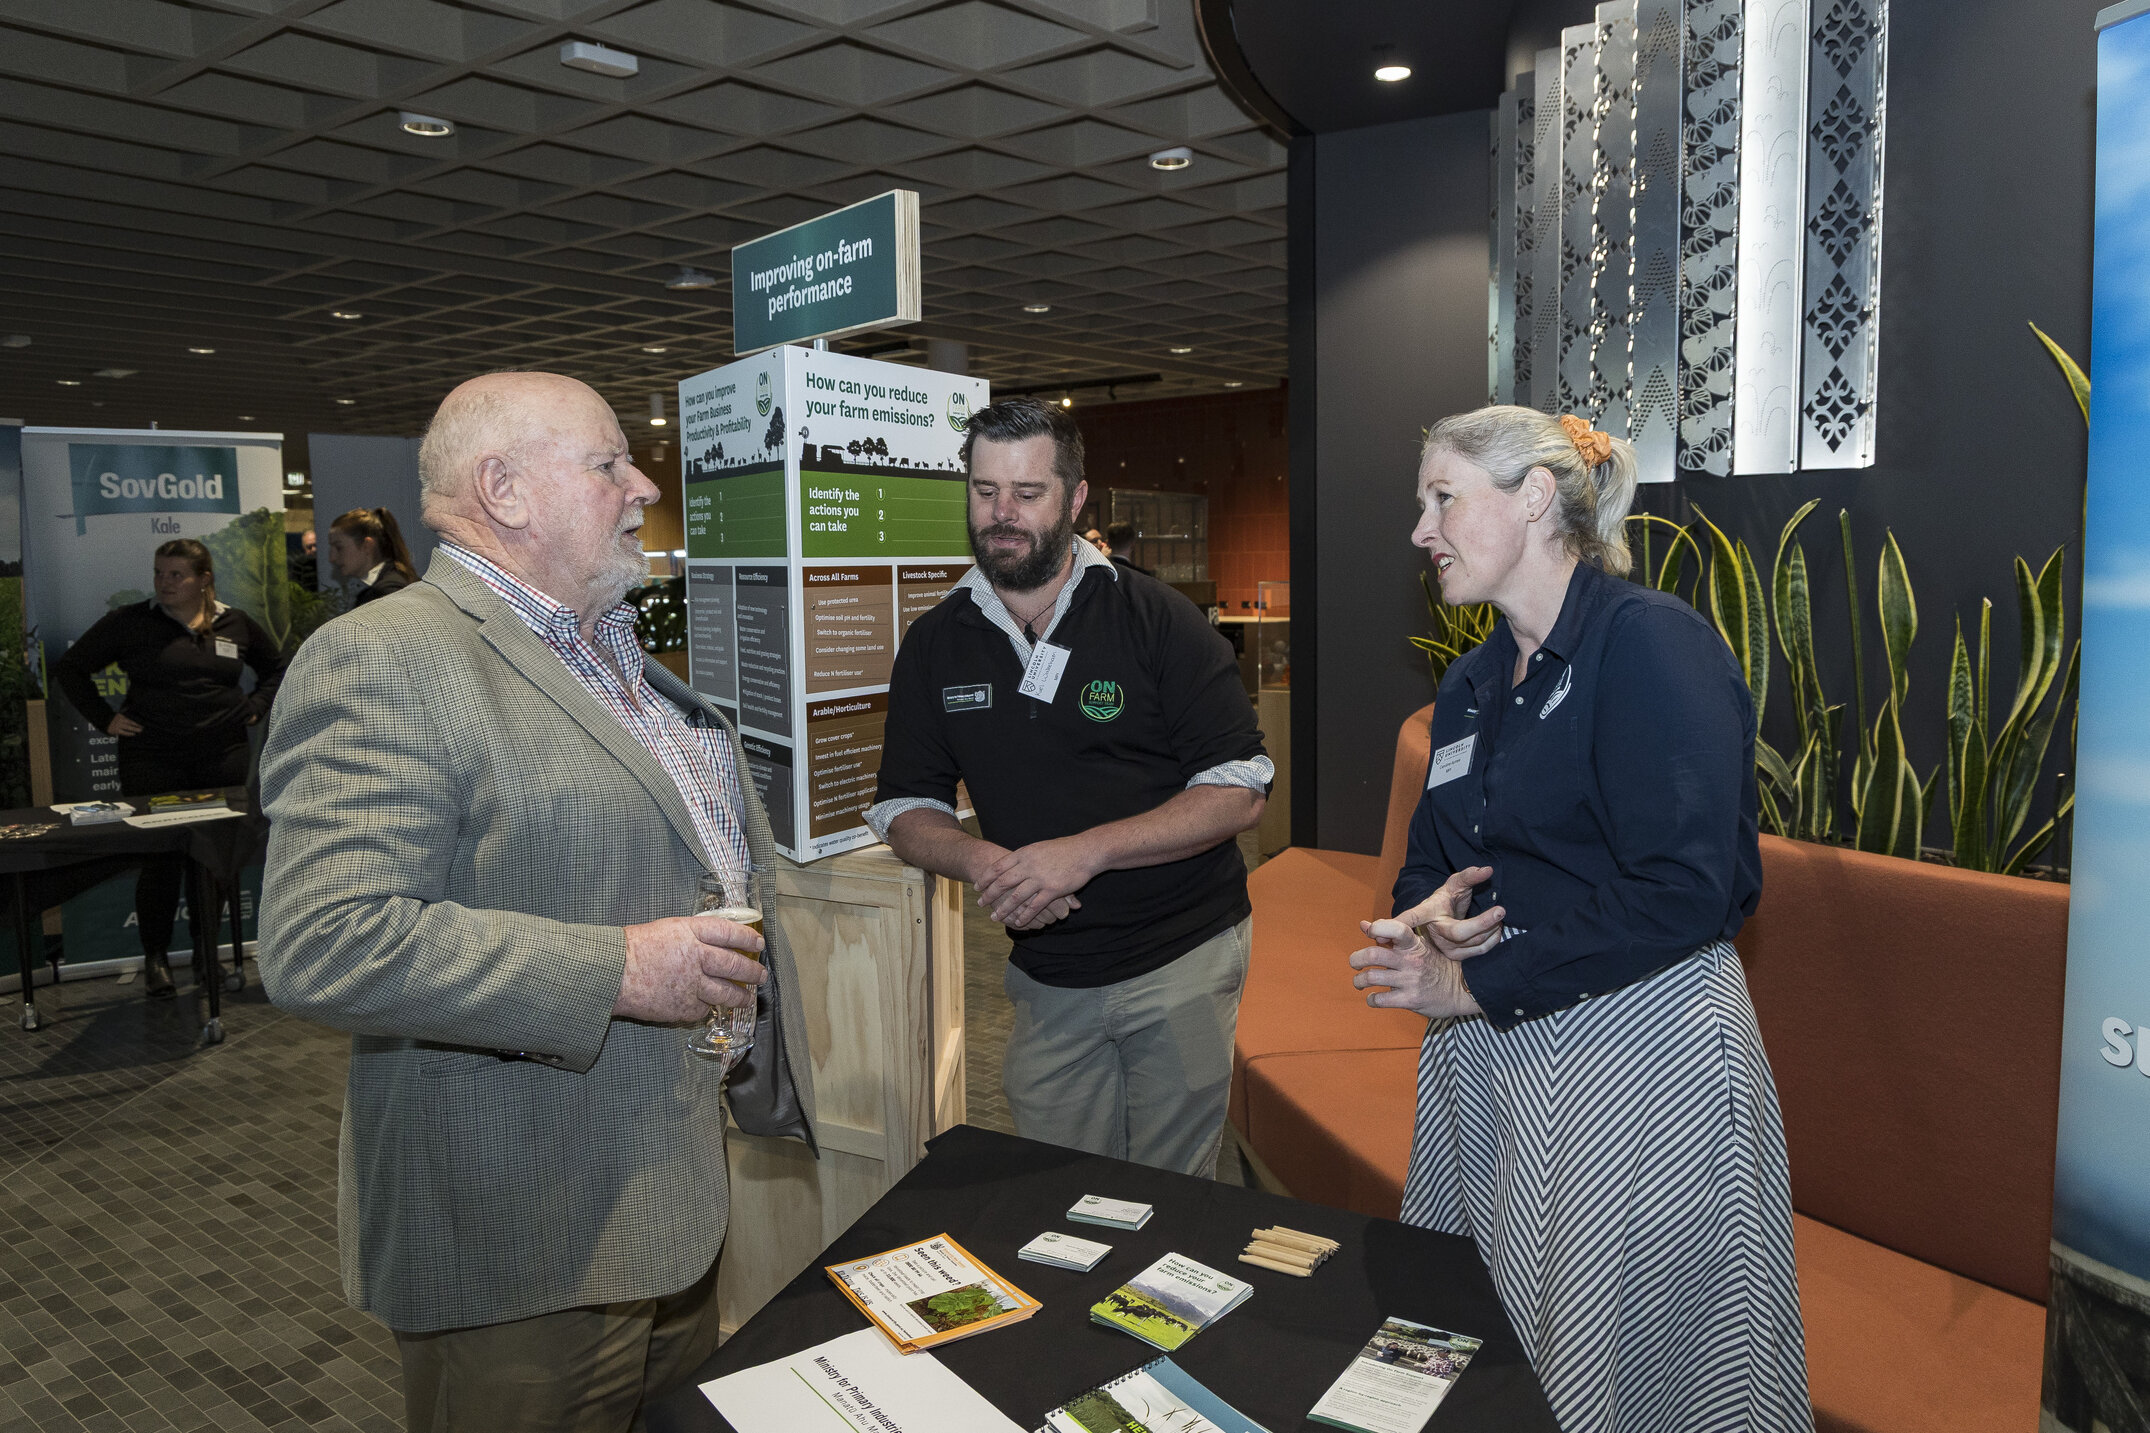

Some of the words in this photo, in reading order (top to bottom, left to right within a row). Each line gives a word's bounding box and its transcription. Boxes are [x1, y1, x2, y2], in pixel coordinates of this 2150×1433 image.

[751, 255, 814, 293] Improving
[816, 237, 872, 272] on-farm
[768, 275, 852, 320] performance
[759, 371, 768, 386] ON
[685, 394, 696, 407] How
[696, 393, 705, 403] can
[705, 390, 714, 405] you
[714, 383, 736, 400] improve
[806, 372, 835, 391] How
[839, 379, 861, 394] can
[864, 384, 886, 400] you
[888, 386, 928, 404] reduce
[952, 392, 964, 406] ON
[686, 413, 696, 428] your
[697, 410, 709, 422] Farm
[710, 404, 732, 418] Business
[806, 400, 836, 418] your
[840, 400, 869, 420] farm
[872, 406, 935, 428] emissions?
[686, 425, 715, 442] Productivity
[715, 424, 719, 436] &
[720, 416, 751, 436] Profitability
[100, 472, 223, 499] SovGold
[878, 488, 883, 498] 1
[689, 496, 704, 508] Identify
[809, 487, 844, 503] Identify
[845, 489, 860, 501] the
[690, 511, 703, 521] actions
[809, 504, 842, 516] actions
[843, 506, 860, 520] you
[151, 516, 180, 534] Kale
[698, 525, 706, 535] take
[810, 522, 826, 532] can
[827, 520, 847, 532] take
[903, 571, 927, 579] Livestock
[928, 570, 947, 580] Specific
[827, 597, 848, 606] protected
[860, 614, 875, 622] fertility
[1028, 655, 1039, 678] LINCOLN
[1032, 646, 1046, 680] UNIVERSITY
[1090, 680, 1115, 693] ON
[1089, 692, 1115, 702] FARM
[813, 702, 871, 717] Arable/Horticulture
[844, 747, 860, 755] efficient
[861, 744, 882, 752] machinery
[90, 754, 117, 764] Late
[814, 768, 834, 777] Optimise
[834, 764, 852, 772] fertiliser
[840, 777, 855, 785] electric
[856, 772, 877, 781] machinery
[93, 780, 121, 792] early
[814, 797, 833, 807] Optimise
[838, 791, 856, 801] fertiliser
[857, 786, 878, 796] applicatio
[816, 812, 835, 821] Minimise
[836, 805, 858, 815] machinery
[914, 1247, 930, 1261] Seen
[928, 1259, 942, 1270] this
[938, 1267, 961, 1286] weed?
[1162, 1263, 1187, 1276] reduce
[1188, 1274, 1205, 1283] your
[1168, 1258, 1185, 1268] How
[1186, 1266, 1199, 1275] can
[1199, 1271, 1214, 1280] you
[1157, 1267, 1174, 1277] farm
[1175, 1275, 1217, 1295] emissions?
[813, 1356, 842, 1380] Ministry
[837, 1378, 851, 1388] for
[846, 1386, 874, 1410] Primary
[854, 1413, 868, 1426] Ahu
